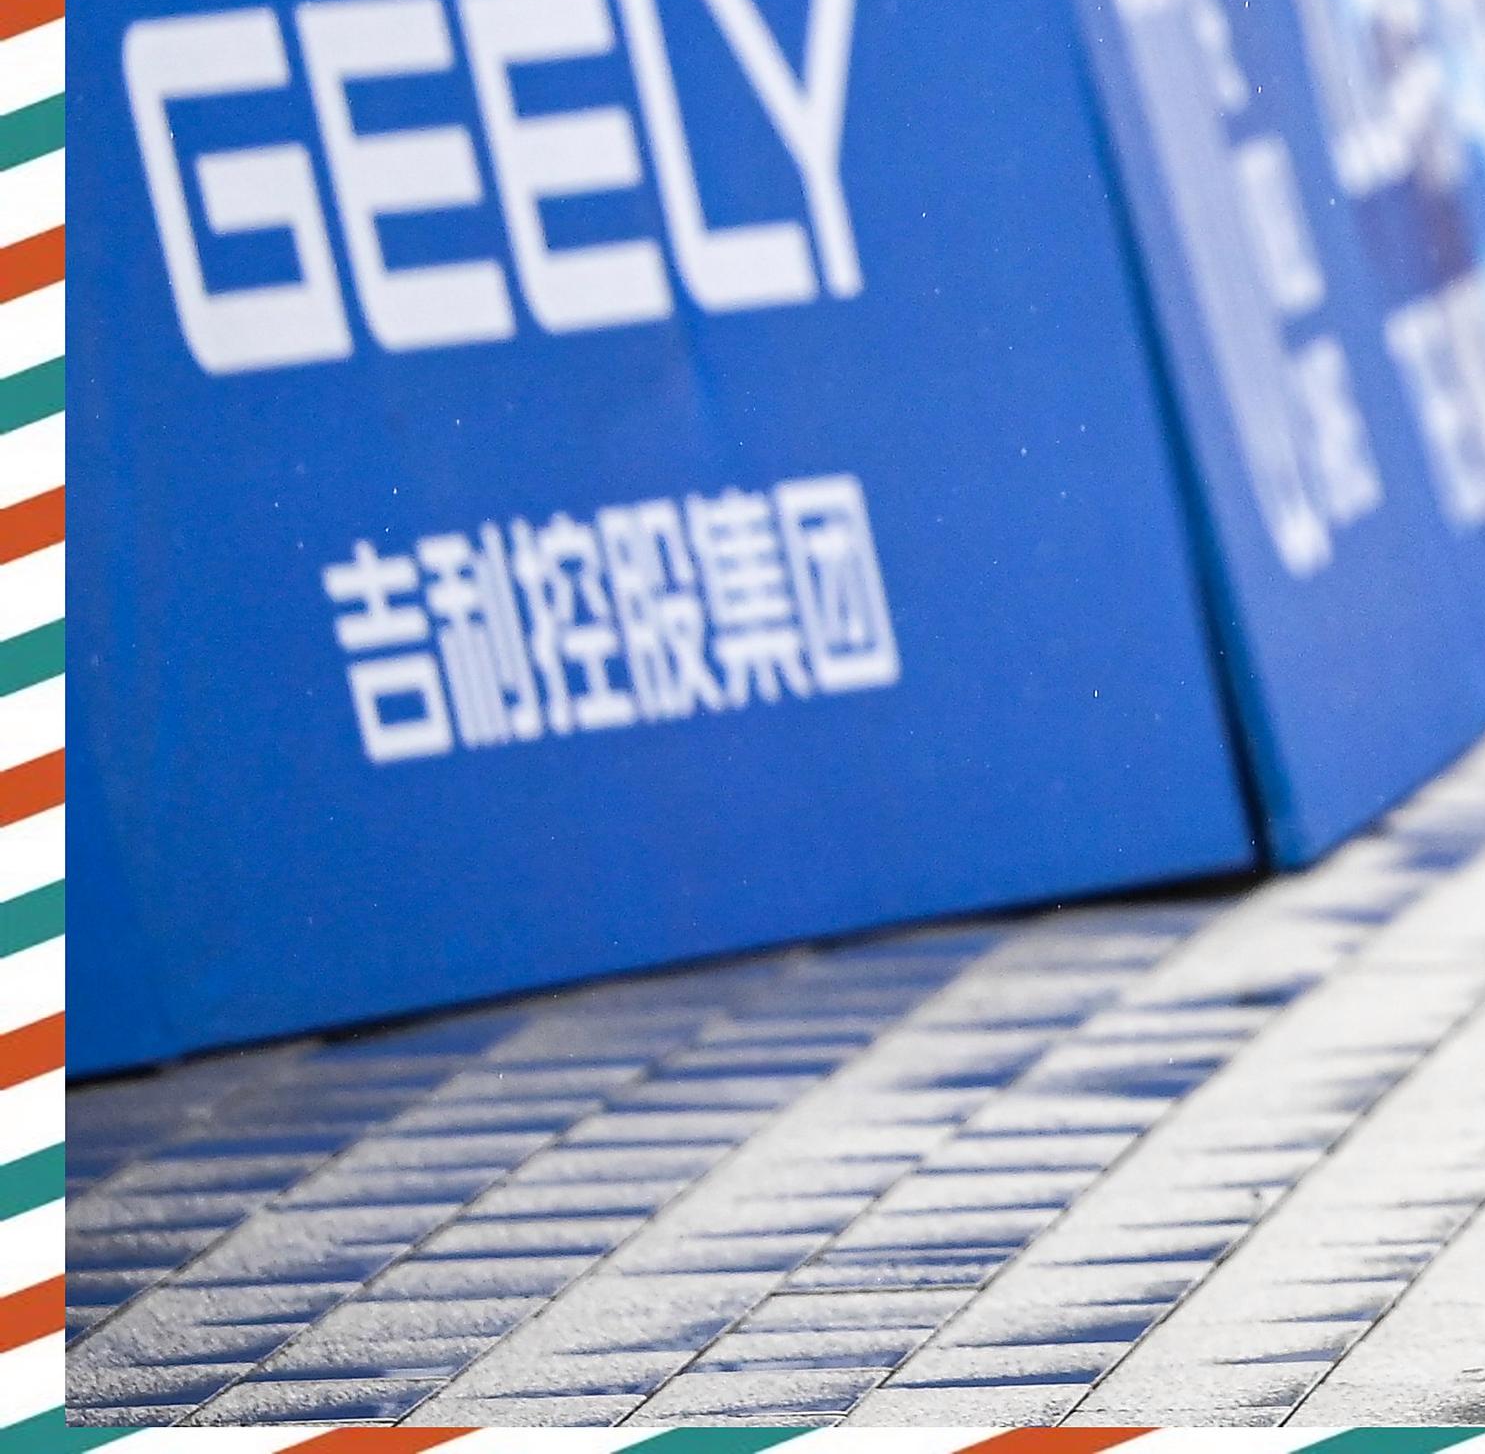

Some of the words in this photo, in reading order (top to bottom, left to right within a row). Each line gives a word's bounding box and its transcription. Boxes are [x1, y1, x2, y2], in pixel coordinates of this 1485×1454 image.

[322, 474, 900, 766] 吉利控股集团
